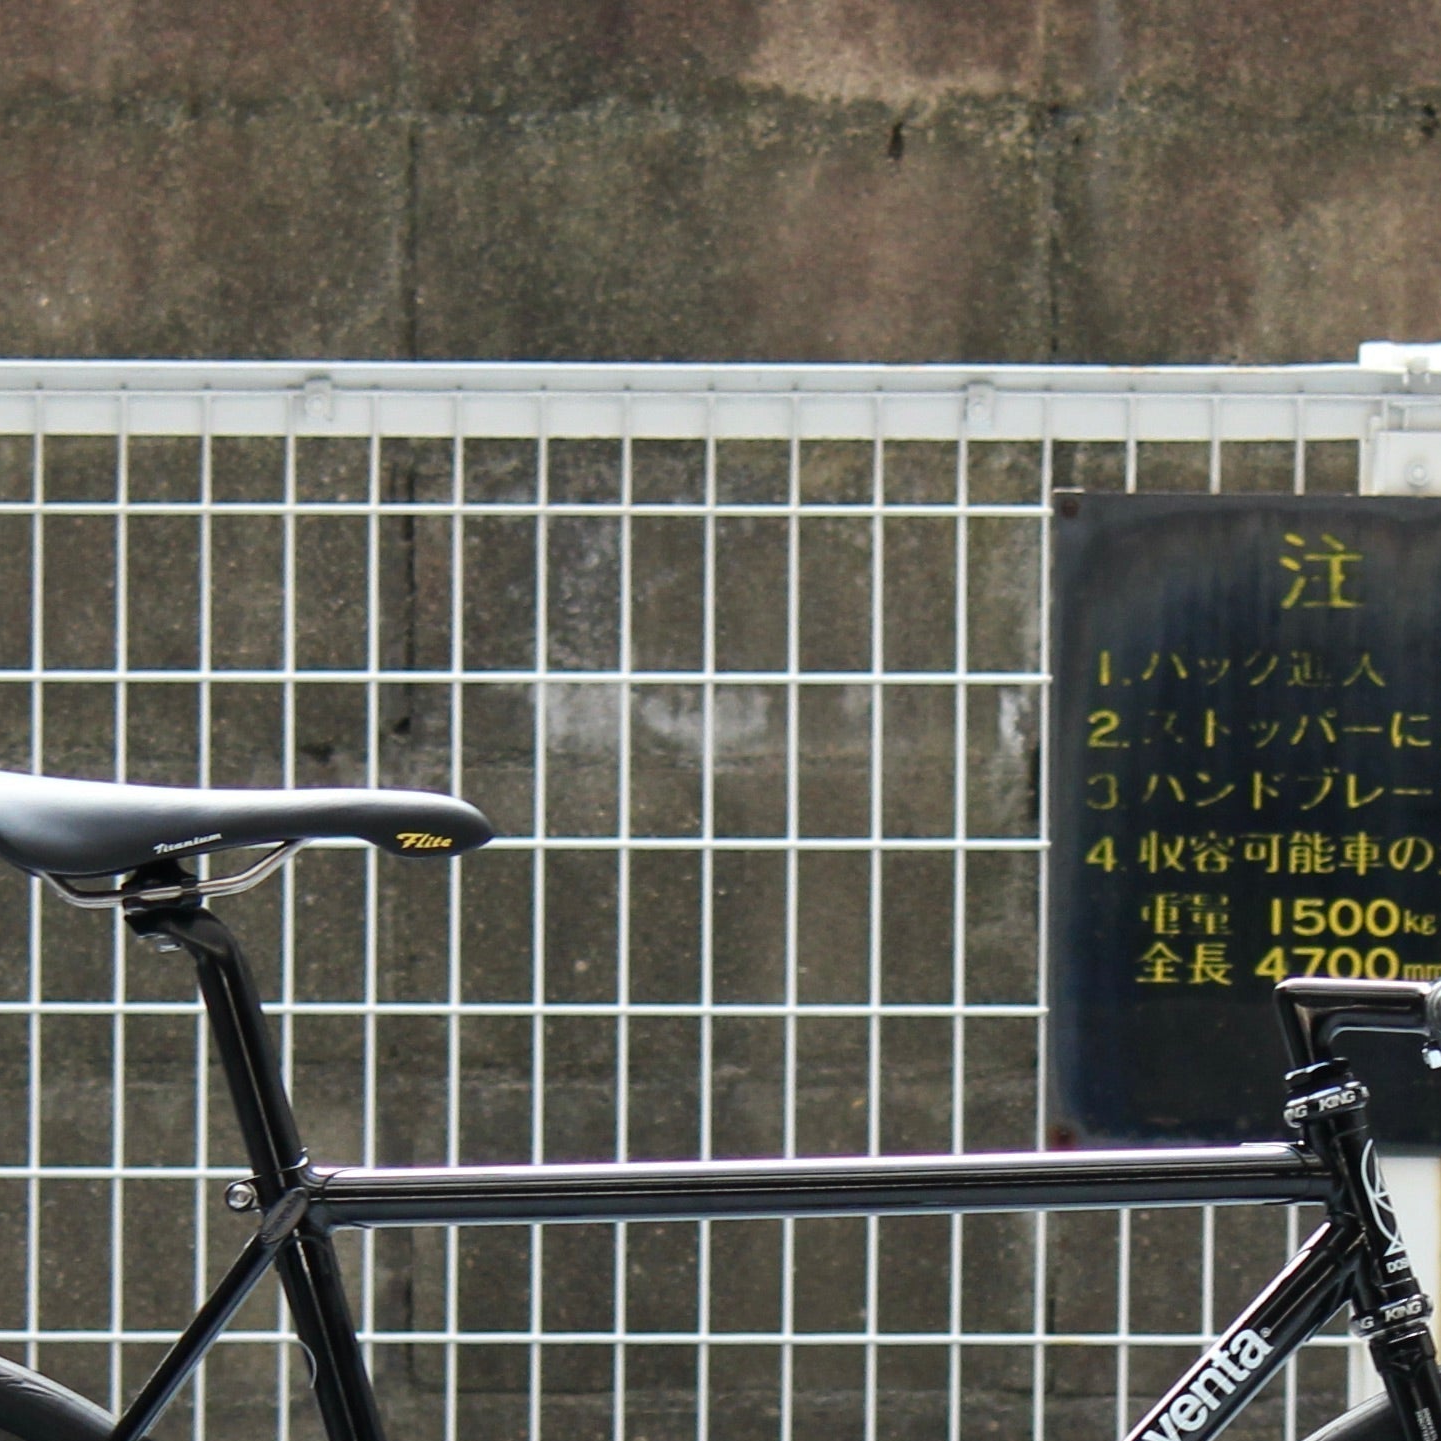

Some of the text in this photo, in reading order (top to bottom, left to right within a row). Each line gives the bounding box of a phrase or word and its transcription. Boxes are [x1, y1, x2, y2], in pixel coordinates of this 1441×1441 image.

[396, 832, 452, 849] Flite
[1136, 942, 1233, 987] 全長
[1317, 1090, 1356, 1112] KING
[1384, 1301, 1422, 1323] KING
